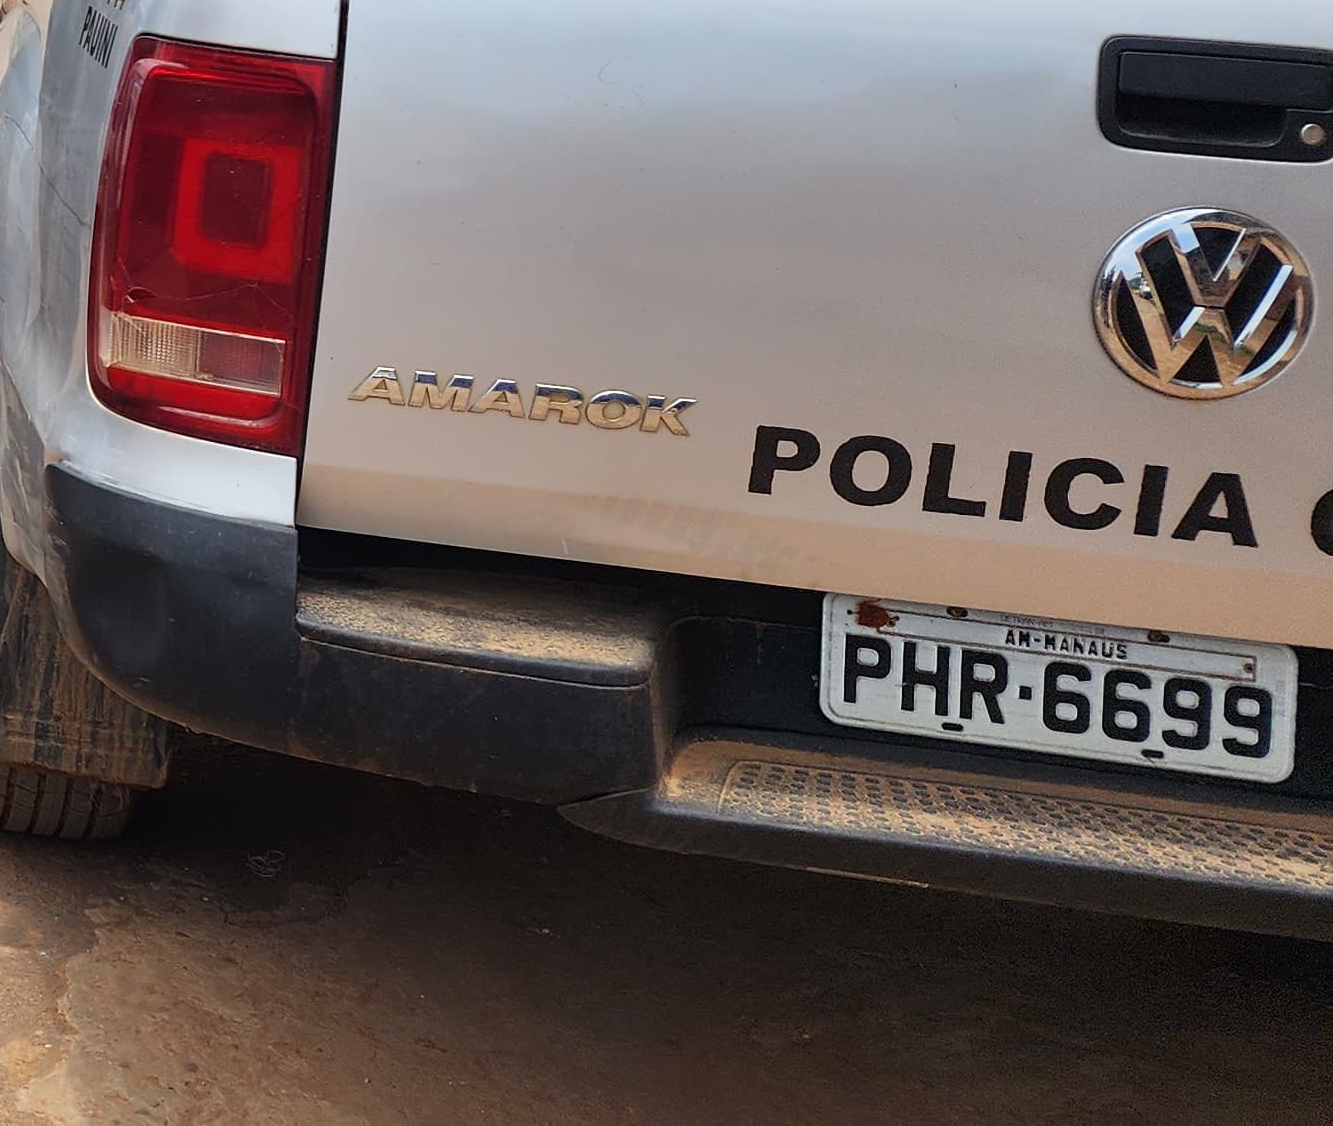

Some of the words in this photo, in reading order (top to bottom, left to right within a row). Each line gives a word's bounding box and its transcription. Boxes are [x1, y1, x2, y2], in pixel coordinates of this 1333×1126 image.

[78, 5, 119, 69] PAUINI
[347, 365, 698, 437] AMAROK
[747, 425, 1259, 549] POLICIA
[1004, 629, 1129, 660] AM-MANAUS
